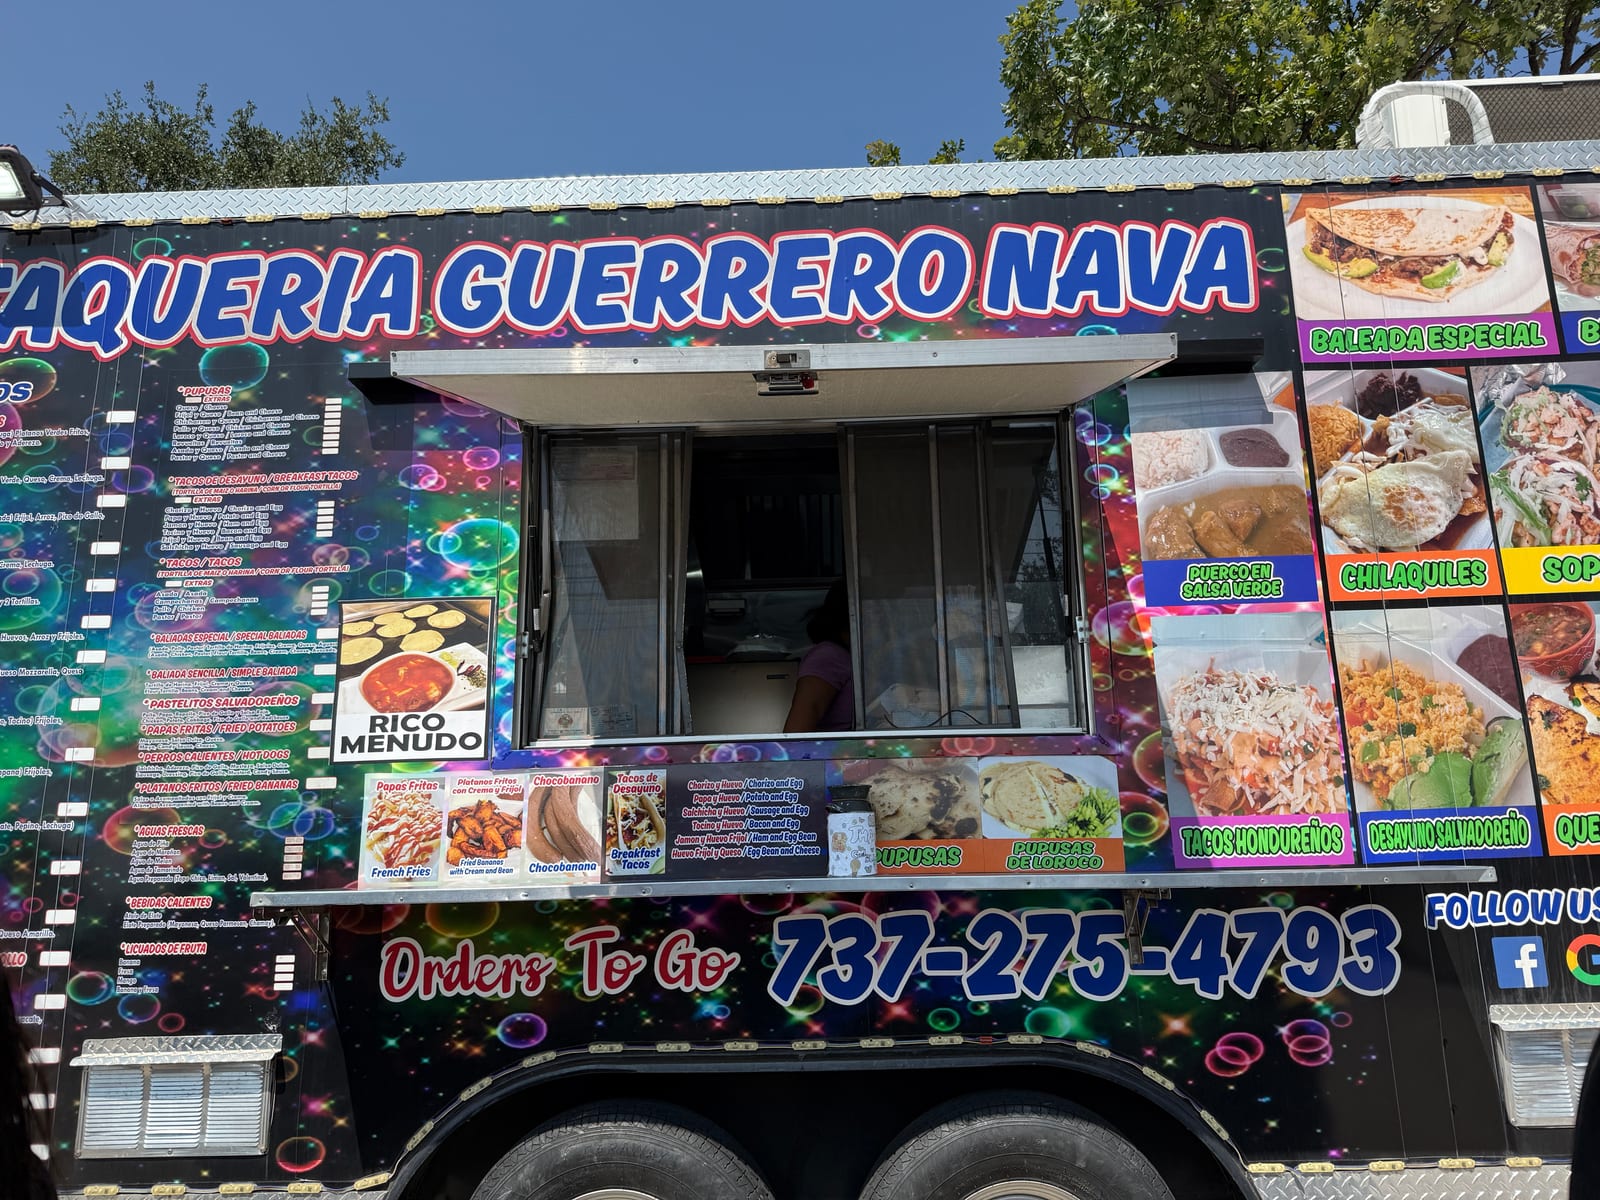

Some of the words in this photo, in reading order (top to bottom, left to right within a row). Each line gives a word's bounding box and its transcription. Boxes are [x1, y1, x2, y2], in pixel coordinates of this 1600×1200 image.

[435, 226, 974, 336] GUERRERO
[982, 218, 1258, 320] NAVA
[1310, 327, 1426, 353] BALEADA
[1427, 322, 1546, 349] ESPECIAL
[175, 476, 205, 486] TACOS
[206, 476, 218, 485] DE
[219, 475, 267, 485] DESAYUNO
[274, 472, 327, 482] BREAKFAST
[328, 471, 358, 480] TACOS
[166, 559, 198, 567] TACOS
[208, 558, 242, 566] TACOS
[1188, 564, 1250, 582] PUERCO
[1250, 562, 1273, 579] EN
[1340, 559, 1488, 593] CHILAQUILES
[1181, 583, 1231, 600] SALSA
[1232, 580, 1283, 598] VERDE
[155, 634, 193, 642] BALIADAS
[194, 633, 229, 641] ESPECIAL
[235, 632, 268, 640] SPECIAL
[269, 631, 307, 640] BALIADAS
[151, 670, 186, 679] BALIADA
[188, 669, 226, 678] SENCILLA
[232, 667, 261, 677] SIMPLE
[262, 667, 297, 676] BALIADA
[150, 699, 214, 709] PASTELITOS
[215, 695, 299, 708] SALVADOREÑOS
[147, 725, 177, 734] PAPAS
[179, 724, 212, 733] FRITAS
[219, 723, 247, 733] FRIED
[250, 722, 296, 732] POTATOES
[369, 713, 445, 733] RICO
[340, 732, 482, 754] MENUDO
[144, 753, 183, 762] PERROS
[184, 752, 234, 761] CALIENTES
[242, 750, 264, 760] HOT
[264, 750, 290, 759] DOGS
[457, 778, 493, 786] Platanos
[495, 777, 517, 785] Fritos
[533, 775, 599, 786] Chocobanano
[617, 773, 645, 784] Tacos
[646, 773, 657, 782] de
[140, 782, 187, 792] PLATANOS
[189, 781, 220, 791] FRITOS
[227, 780, 254, 790] FRIED
[255, 779, 299, 790] BANANAS
[377, 782, 408, 792] Papas
[408, 781, 438, 792] Fritas
[495, 787, 500, 795] y
[501, 785, 522, 794] Frijol
[613, 784, 661, 795] Desayuno
[688, 781, 714, 791] Chorizo
[715, 782, 720, 791] y
[721, 781, 743, 790] Huevo
[749, 779, 775, 788] Chorizo
[776, 779, 789, 788] and
[790, 779, 803, 790] Egg
[693, 795, 712, 804] Papa
[713, 796, 718, 804] y
[718, 794, 740, 803] Huevo
[746, 793, 769, 802] Potato
[769, 793, 783, 801] and
[784, 792, 798, 803] Egg
[682, 808, 718, 817] Salchicha
[718, 809, 723, 817] y
[724, 807, 745, 817] Huevo
[751, 806, 781, 816] Sausage
[782, 806, 795, 815] and
[796, 806, 809, 816] Egg
[14, 822, 41, 831] Pepino,
[42, 821, 74, 830] Lechuga)
[138, 826, 167, 837] AGUAS
[167, 825, 205, 836] FRESCAS
[1368, 818, 1436, 854] DESAYUNO
[1436, 809, 1531, 850] SALVADOREÑO
[675, 835, 700, 844] Jamon
[701, 836, 706, 844] y
[706, 834, 728, 844] Huevo
[729, 833, 747, 843] Frijol
[753, 833, 769, 842] Ham
[769, 833, 784, 842] and
[784, 832, 798, 843] Egg
[798, 832, 817, 841] Bean
[1181, 826, 1235, 858] TACOS
[1235, 817, 1345, 857] HONDUREÑOS
[611, 848, 660, 859] Breakfast
[1013, 841, 1096, 856] PUPUSAS
[460, 858, 477, 866] Fried
[529, 862, 597, 873] Chocobanana
[622, 860, 650, 870] Tacos
[1007, 855, 1030, 870] DE
[1031, 853, 1103, 870] LOROCO
[371, 868, 405, 877] French
[406, 867, 431, 877] Fries
[130, 898, 167, 908] BEBIDAS
[167, 896, 212, 908] CALIENTES
[1425, 889, 1565, 929] FOLLOW
[125, 943, 168, 954] LICUADOS
[168, 943, 180, 954] DE
[180, 942, 207, 953] FRUTA
[767, 905, 1402, 1006] 737-275-4793
[380, 937, 556, 1001] Orders
[565, 926, 646, 996] To
[655, 929, 741, 995] Go
